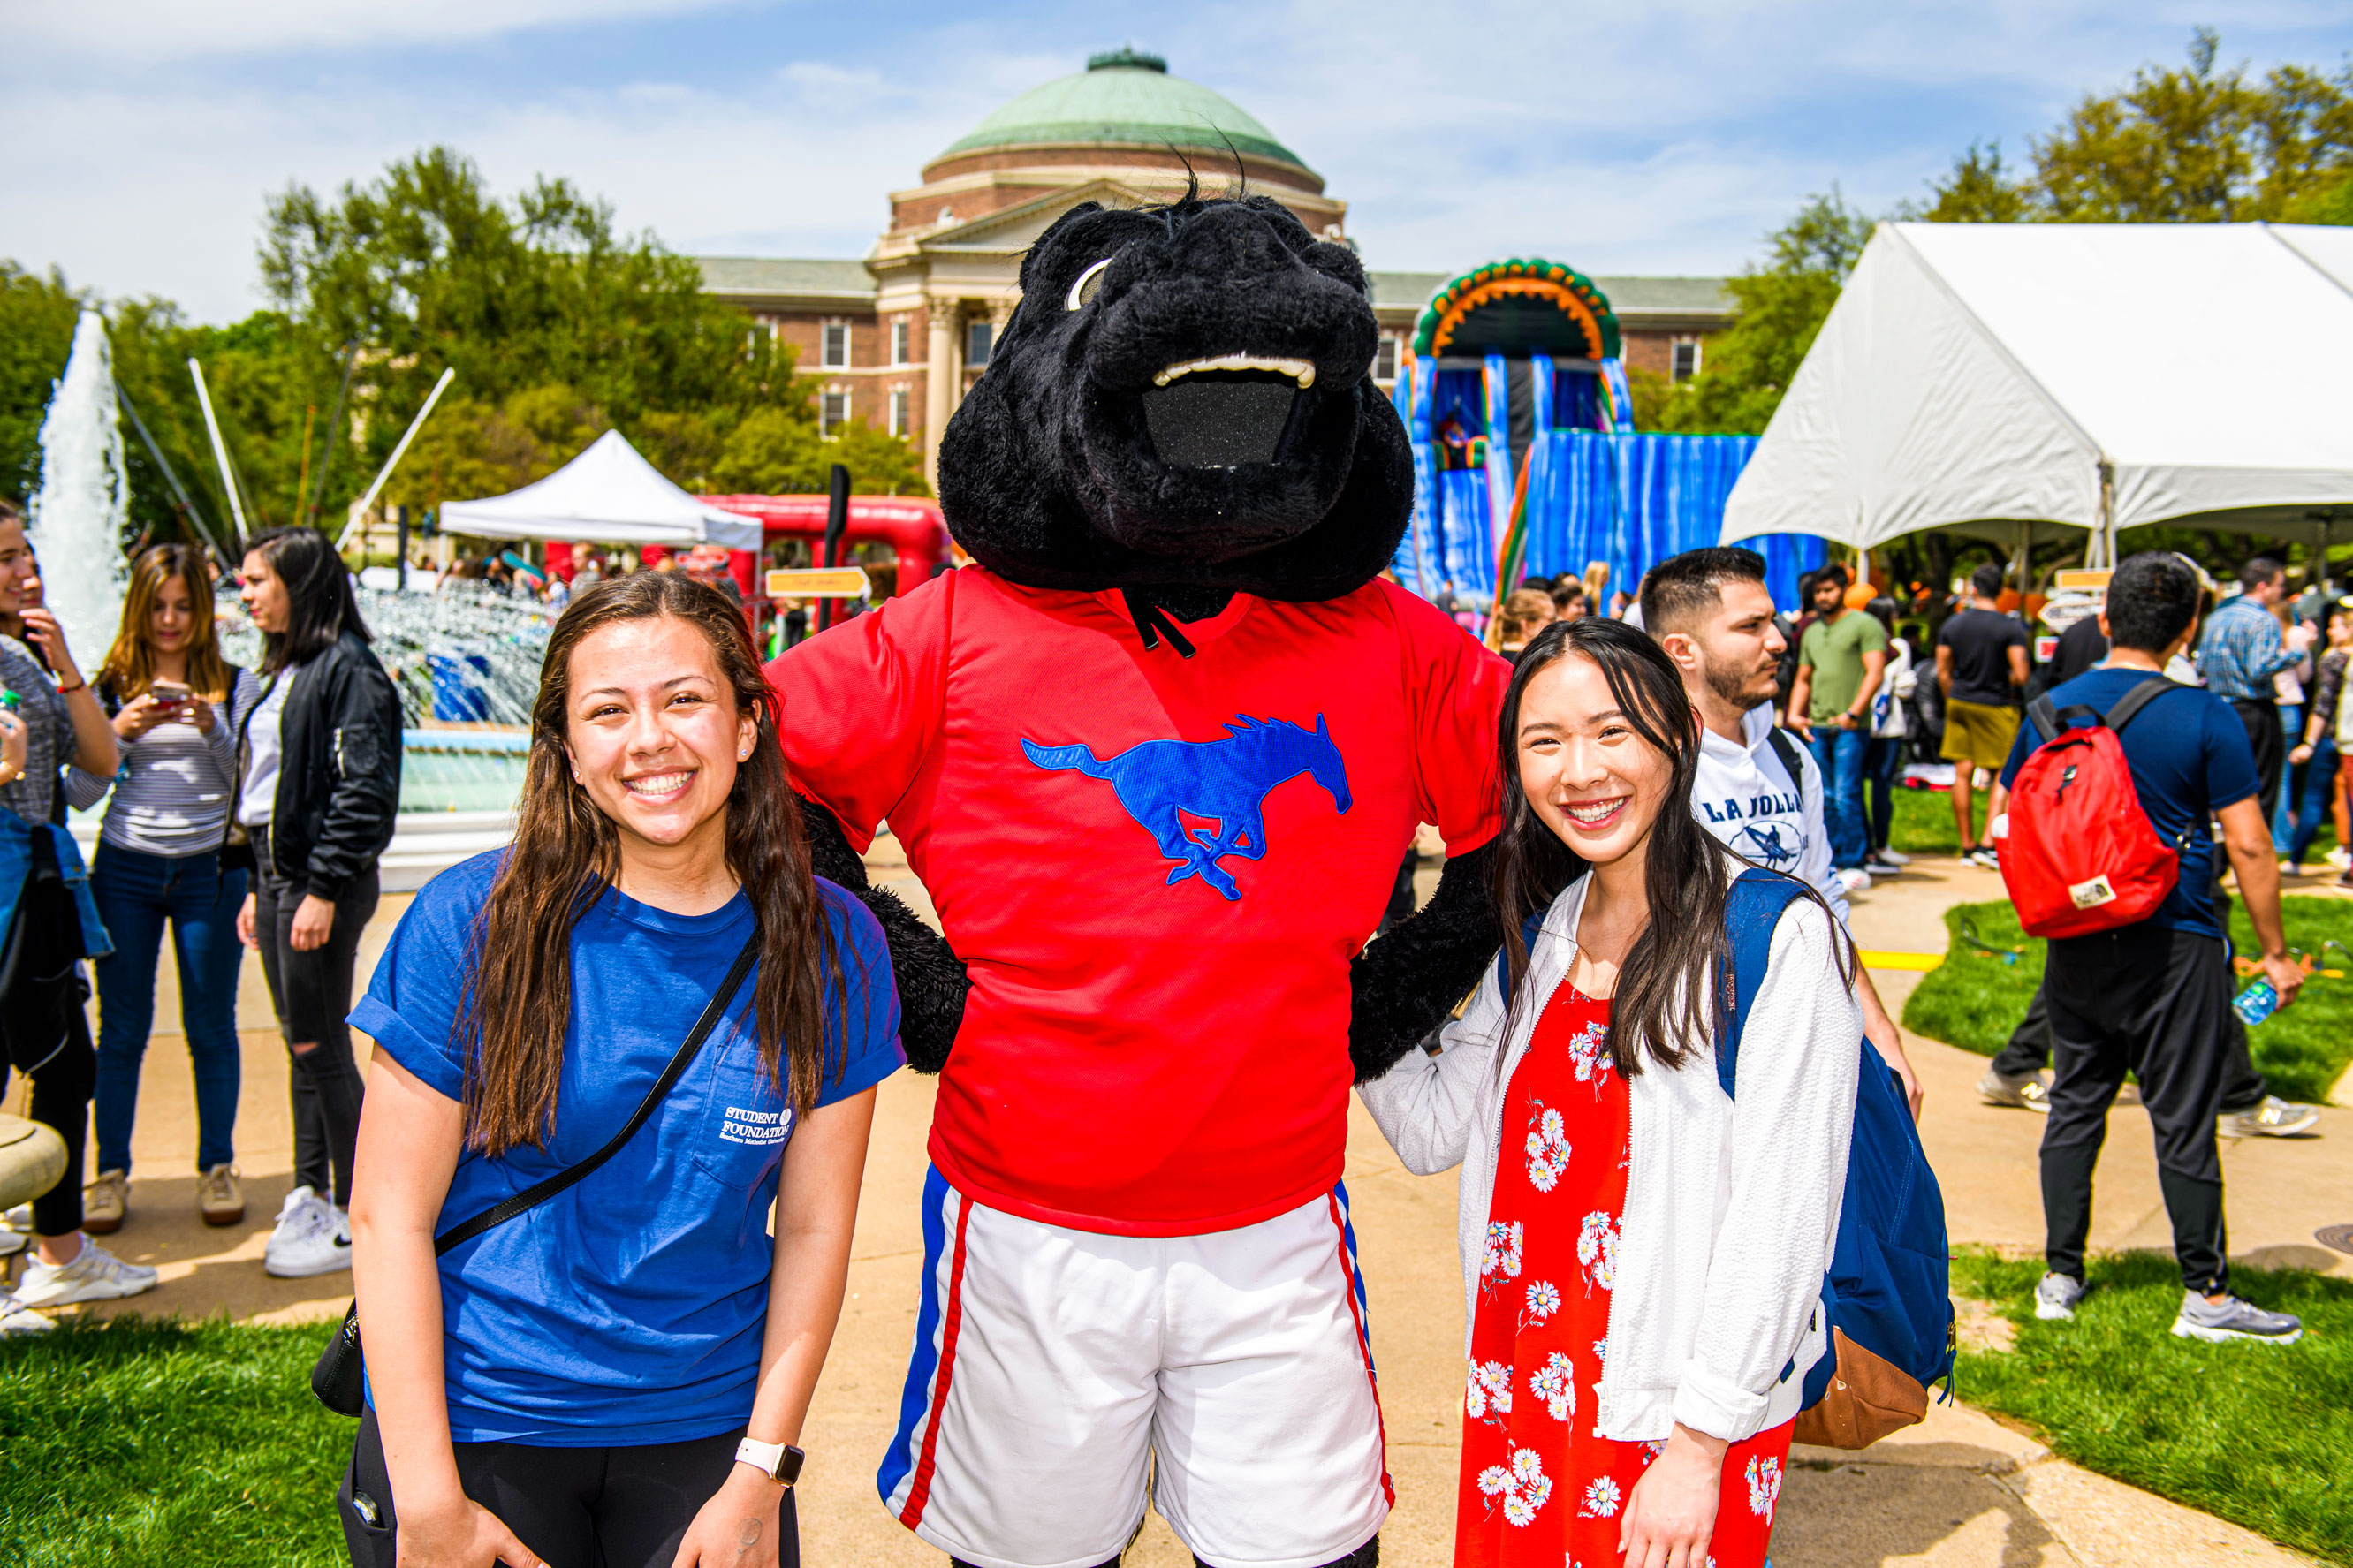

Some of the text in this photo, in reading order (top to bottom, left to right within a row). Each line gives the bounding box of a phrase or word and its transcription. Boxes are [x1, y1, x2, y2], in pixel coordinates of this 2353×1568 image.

[1702, 799, 1743, 822] LA
[725, 1107, 778, 1124] STUDENT
[2258, 1108, 2281, 1125] N
[721, 1120, 790, 1139] FOUNDATION
